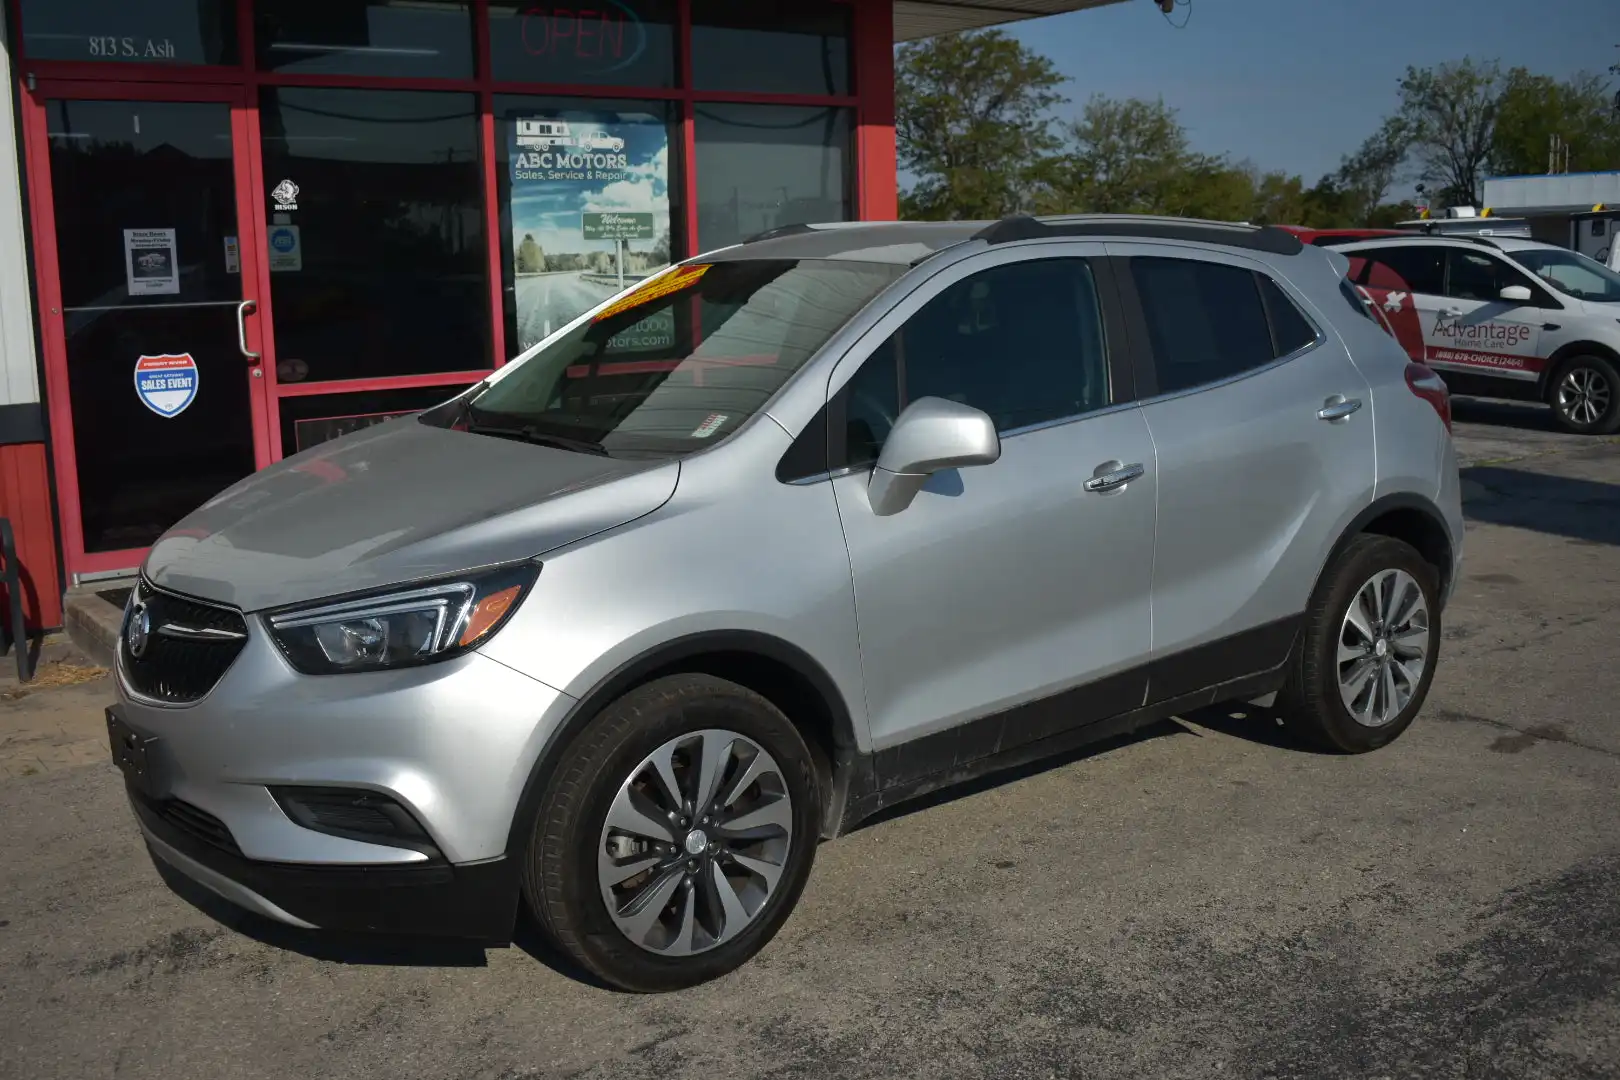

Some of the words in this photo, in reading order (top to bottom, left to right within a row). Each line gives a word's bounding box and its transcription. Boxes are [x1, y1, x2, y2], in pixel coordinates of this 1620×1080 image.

[521, 7, 624, 58] OPEN
[88, 36, 117, 56] 813
[122, 37, 139, 57] S.
[144, 38, 175, 58] Ash
[515, 153, 553, 169] ABC
[556, 153, 627, 169] MOTORS
[515, 170, 546, 181] Sales,
[548, 170, 584, 180] Service
[586, 171, 593, 180] &
[595, 171, 626, 181] Repair
[1432, 319, 1530, 346] Advantage
[1454, 338, 1482, 348] Home
[1484, 339, 1505, 349] Care
[141, 379, 166, 390] SALES
[167, 377, 192, 389] EVENT
